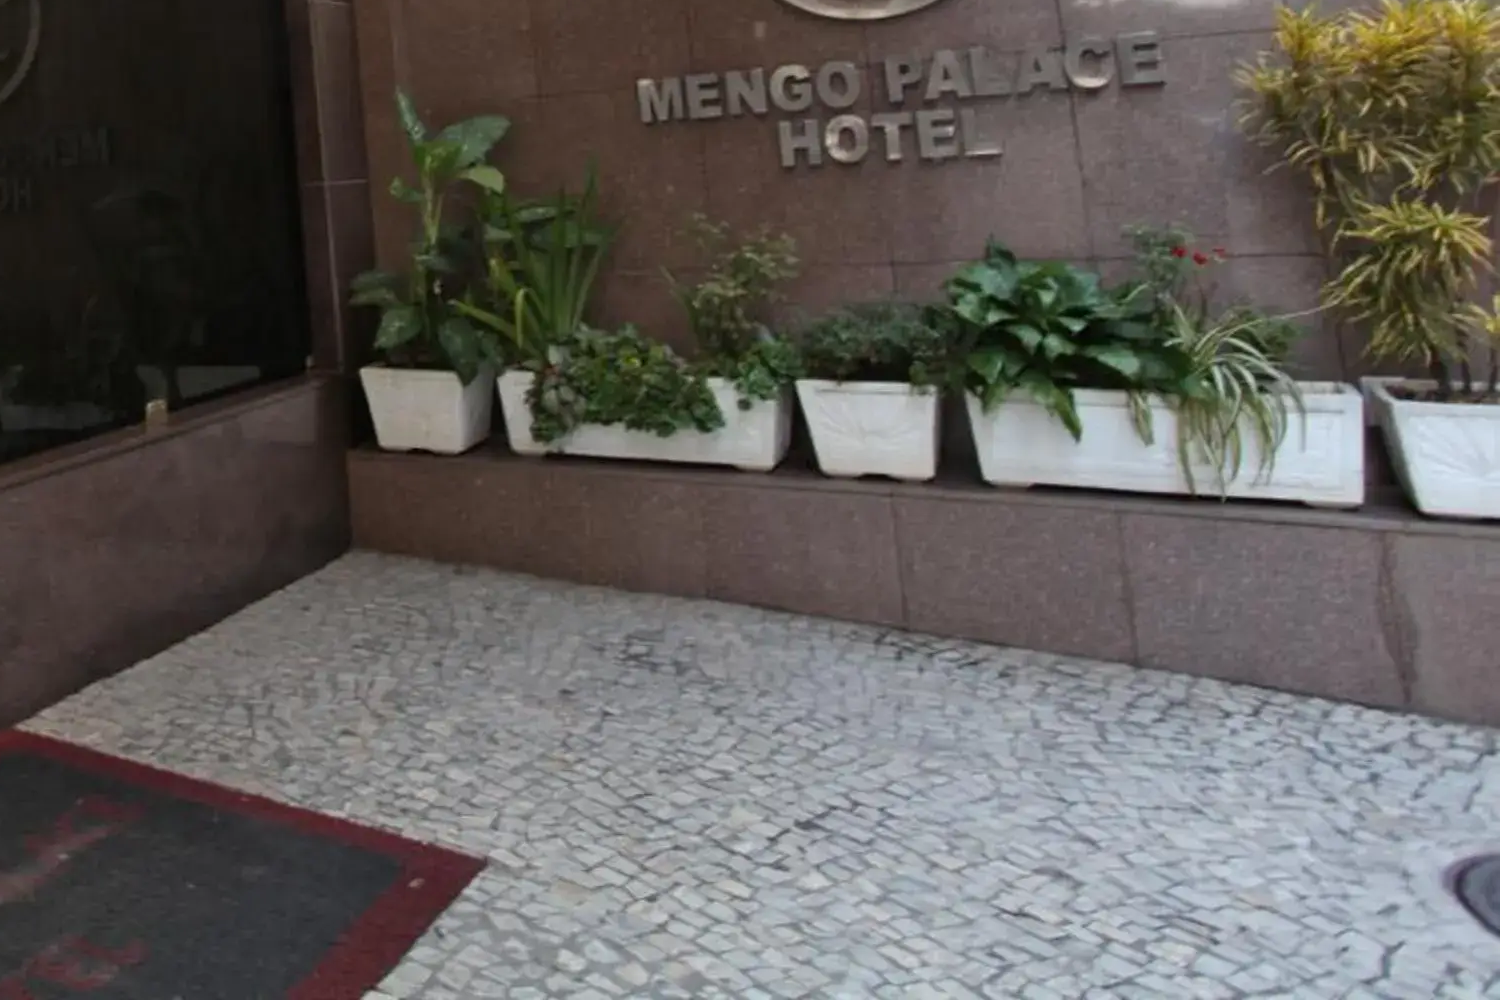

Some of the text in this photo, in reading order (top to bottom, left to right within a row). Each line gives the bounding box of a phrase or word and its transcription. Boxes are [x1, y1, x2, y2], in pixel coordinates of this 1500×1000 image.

[637, 30, 1165, 123] MENGO PALACE
[779, 108, 1003, 168] HOTEL
